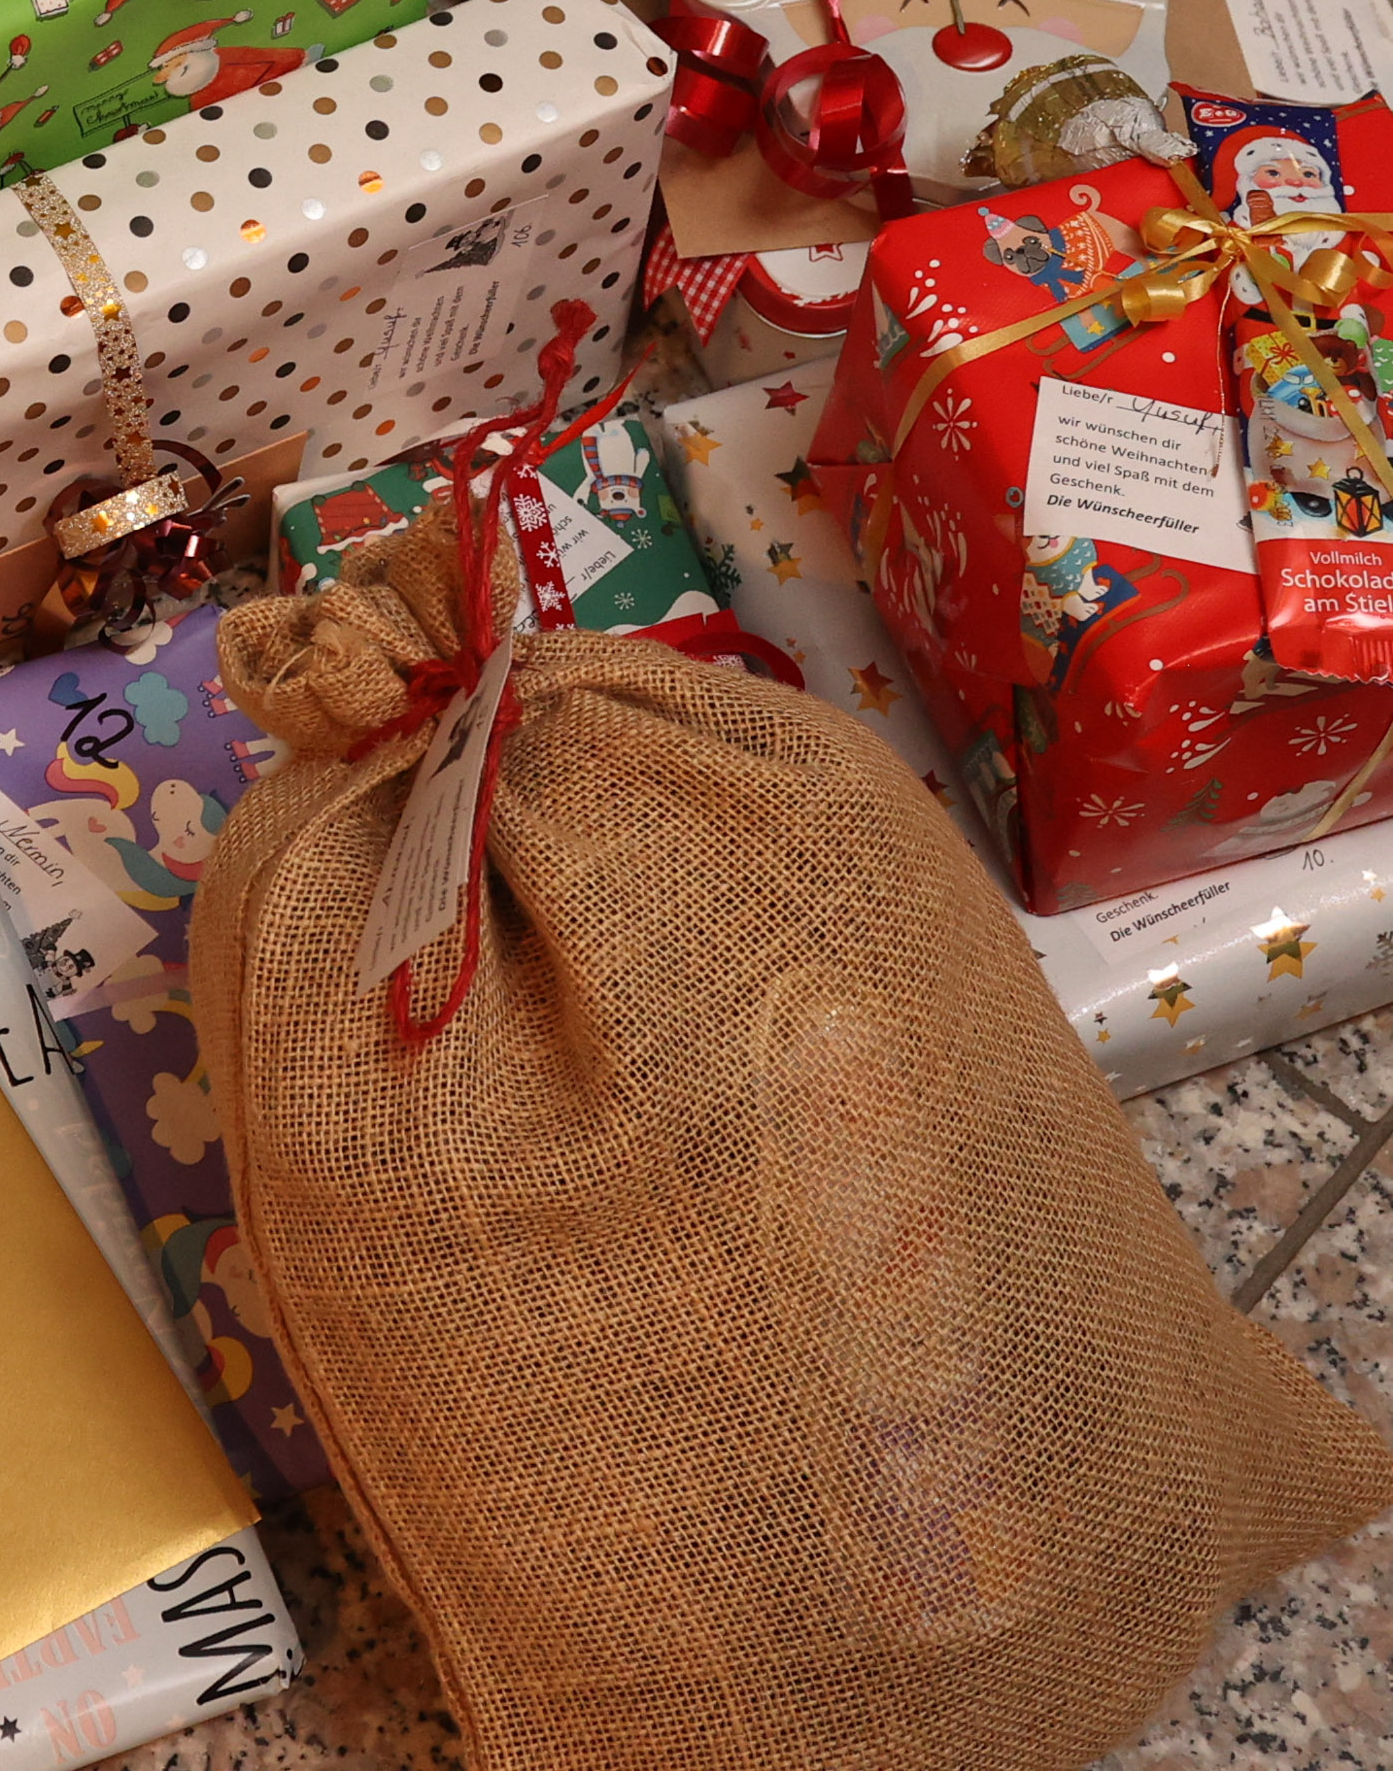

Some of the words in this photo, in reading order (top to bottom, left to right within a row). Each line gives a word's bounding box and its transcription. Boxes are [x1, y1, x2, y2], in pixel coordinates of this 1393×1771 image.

[1062, 384, 1114, 404] Liebe/r
[1058, 416, 1082, 428] wir
[1085, 422, 1158, 446] wünschen
[1161, 438, 1182, 451] dir
[1055, 435, 1107, 454] schöne
[1111, 444, 1208, 476] Weihnachten
[1049, 472, 1125, 497] Geschenk.
[1052, 455, 1081, 468] und
[1084, 460, 1111, 474] viel
[1114, 465, 1150, 483] Spaß
[1153, 476, 1178, 489] mit
[1182, 481, 1215, 498] dem
[1046, 494, 1073, 508] Die
[1077, 498, 1200, 534] Wünscheerfüller
[571, 529, 589, 545] wir
[580, 550, 617, 581] Liebe/r
[1309, 550, 1383, 566] Vollmilch
[1303, 596, 1339, 613] am
[65, 692, 136, 770] 12
[3, 853, 21, 867] dir
[1095, 885, 1159, 924] Geschenk.
[1109, 927, 1133, 943] Die
[1131, 881, 1230, 932] Wünscheerfüller
